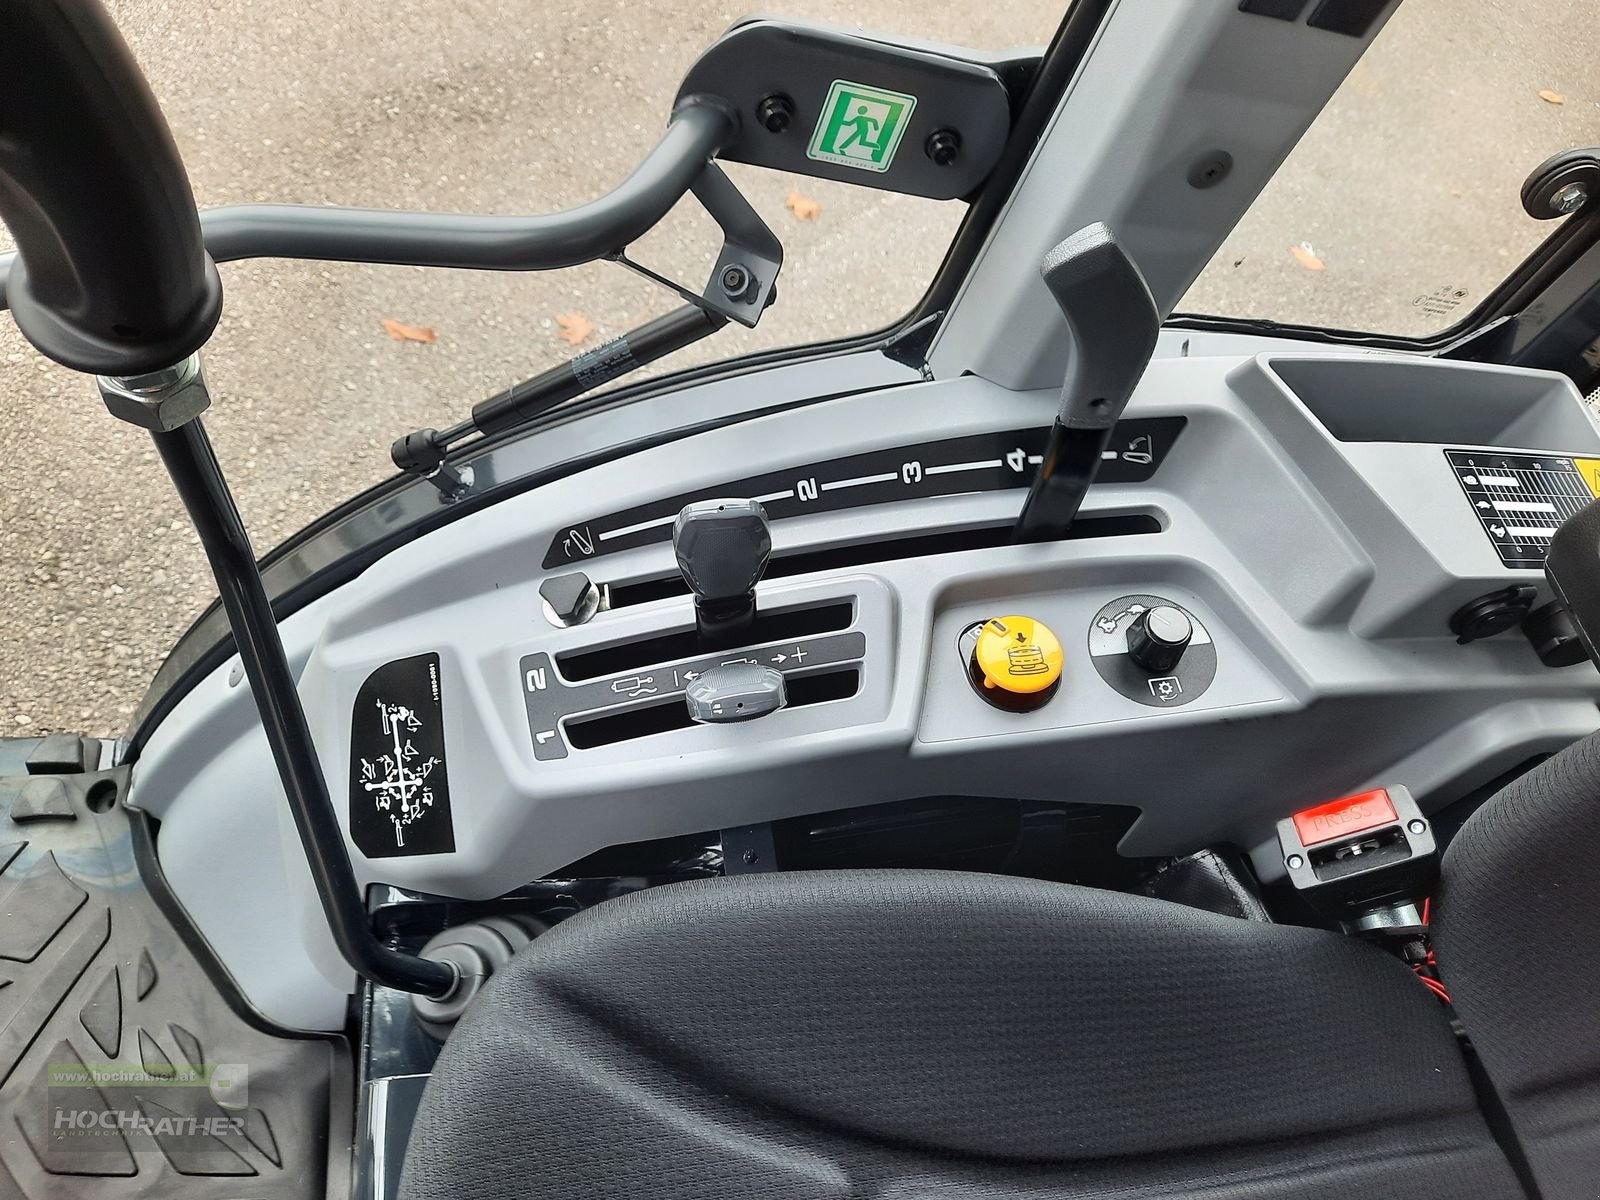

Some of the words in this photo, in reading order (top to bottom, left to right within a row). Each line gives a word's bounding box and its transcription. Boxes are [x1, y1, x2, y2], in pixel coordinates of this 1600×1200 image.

[796, 477, 818, 502] 2
[902, 461, 922, 484] 3
[1006, 447, 1027, 473] 4
[526, 668, 546, 692] 2
[535, 729, 555, 745] 1
[1311, 804, 1372, 832] PRESS
